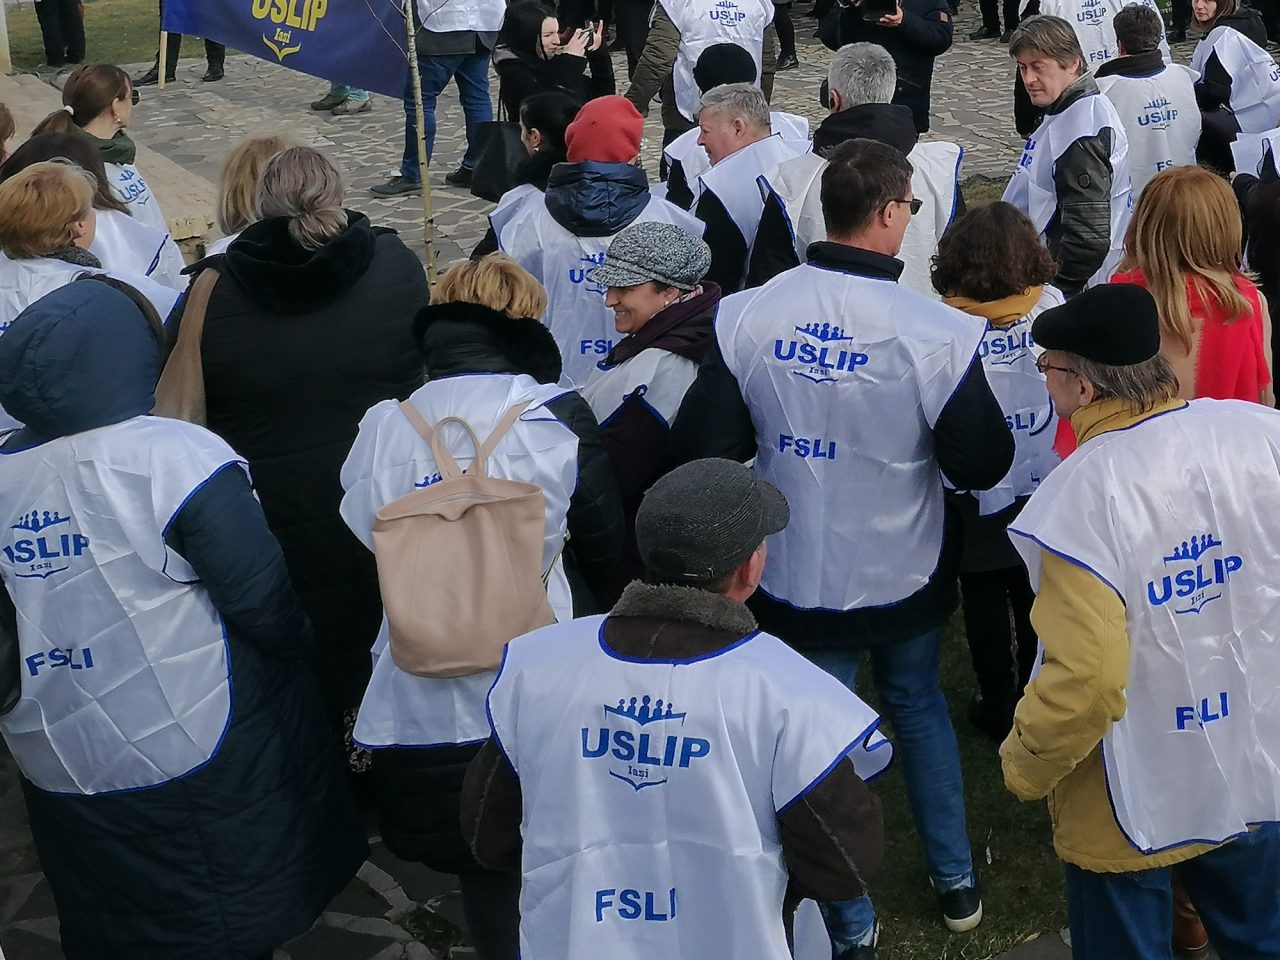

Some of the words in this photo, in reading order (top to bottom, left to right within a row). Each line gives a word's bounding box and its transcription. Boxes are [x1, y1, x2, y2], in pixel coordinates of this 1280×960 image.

[1076, 7, 1107, 22] USLIP
[1136, 109, 1179, 127] USLIP
[580, 339, 613, 355] FSL
[774, 339, 869, 372] USLIP
[779, 433, 836, 460] FSLI
[1147, 555, 1243, 607] USLIP
[25, 647, 94, 677] FSLI
[1175, 691, 1230, 731] FLI
[581, 727, 711, 769] USLIP
[595, 887, 677, 923] FSLI
